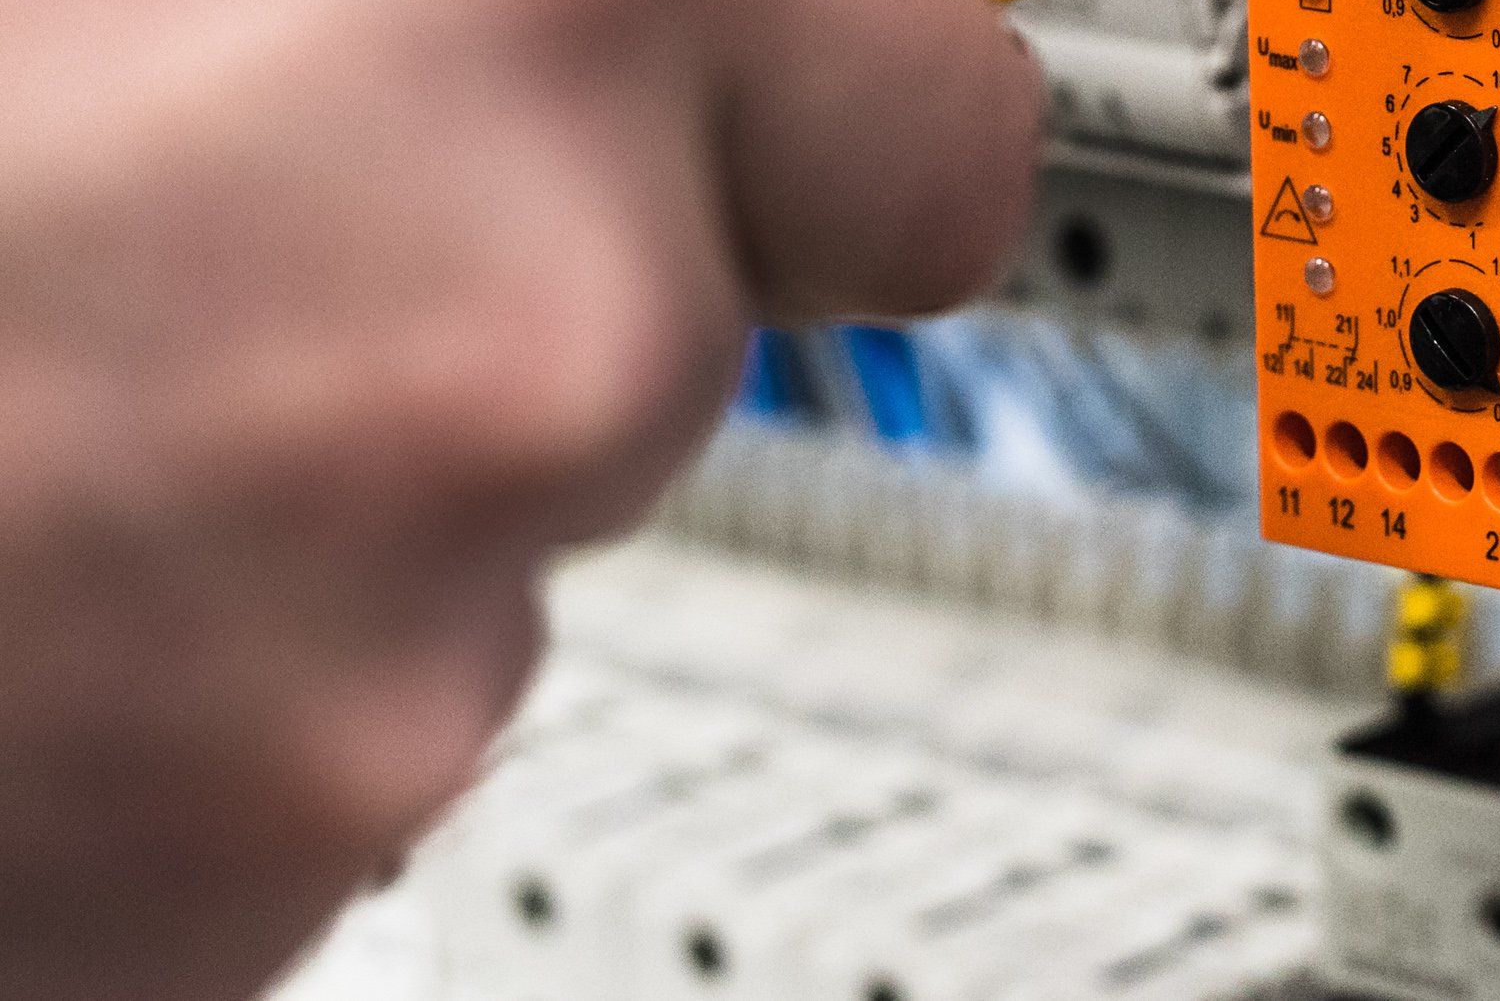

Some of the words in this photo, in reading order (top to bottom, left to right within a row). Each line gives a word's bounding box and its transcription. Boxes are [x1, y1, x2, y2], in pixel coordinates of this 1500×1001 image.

[1402, 64, 1412, 84] 7
[1384, 93, 1395, 114] 6
[1381, 136, 1392, 157] 5
[1391, 179, 1402, 199] 4
[1409, 203, 1420, 224] 3
[1469, 232, 1476, 249] 1
[1390, 255, 1411, 279] 1,1
[1335, 313, 1352, 335] 21
[1375, 307, 1397, 329] 1,0
[1356, 370, 1374, 391] 24
[1389, 369, 1413, 392] 0,9
[1278, 486, 1301, 517] 11
[1328, 497, 1355, 531] 12
[1380, 508, 1407, 540] 14
